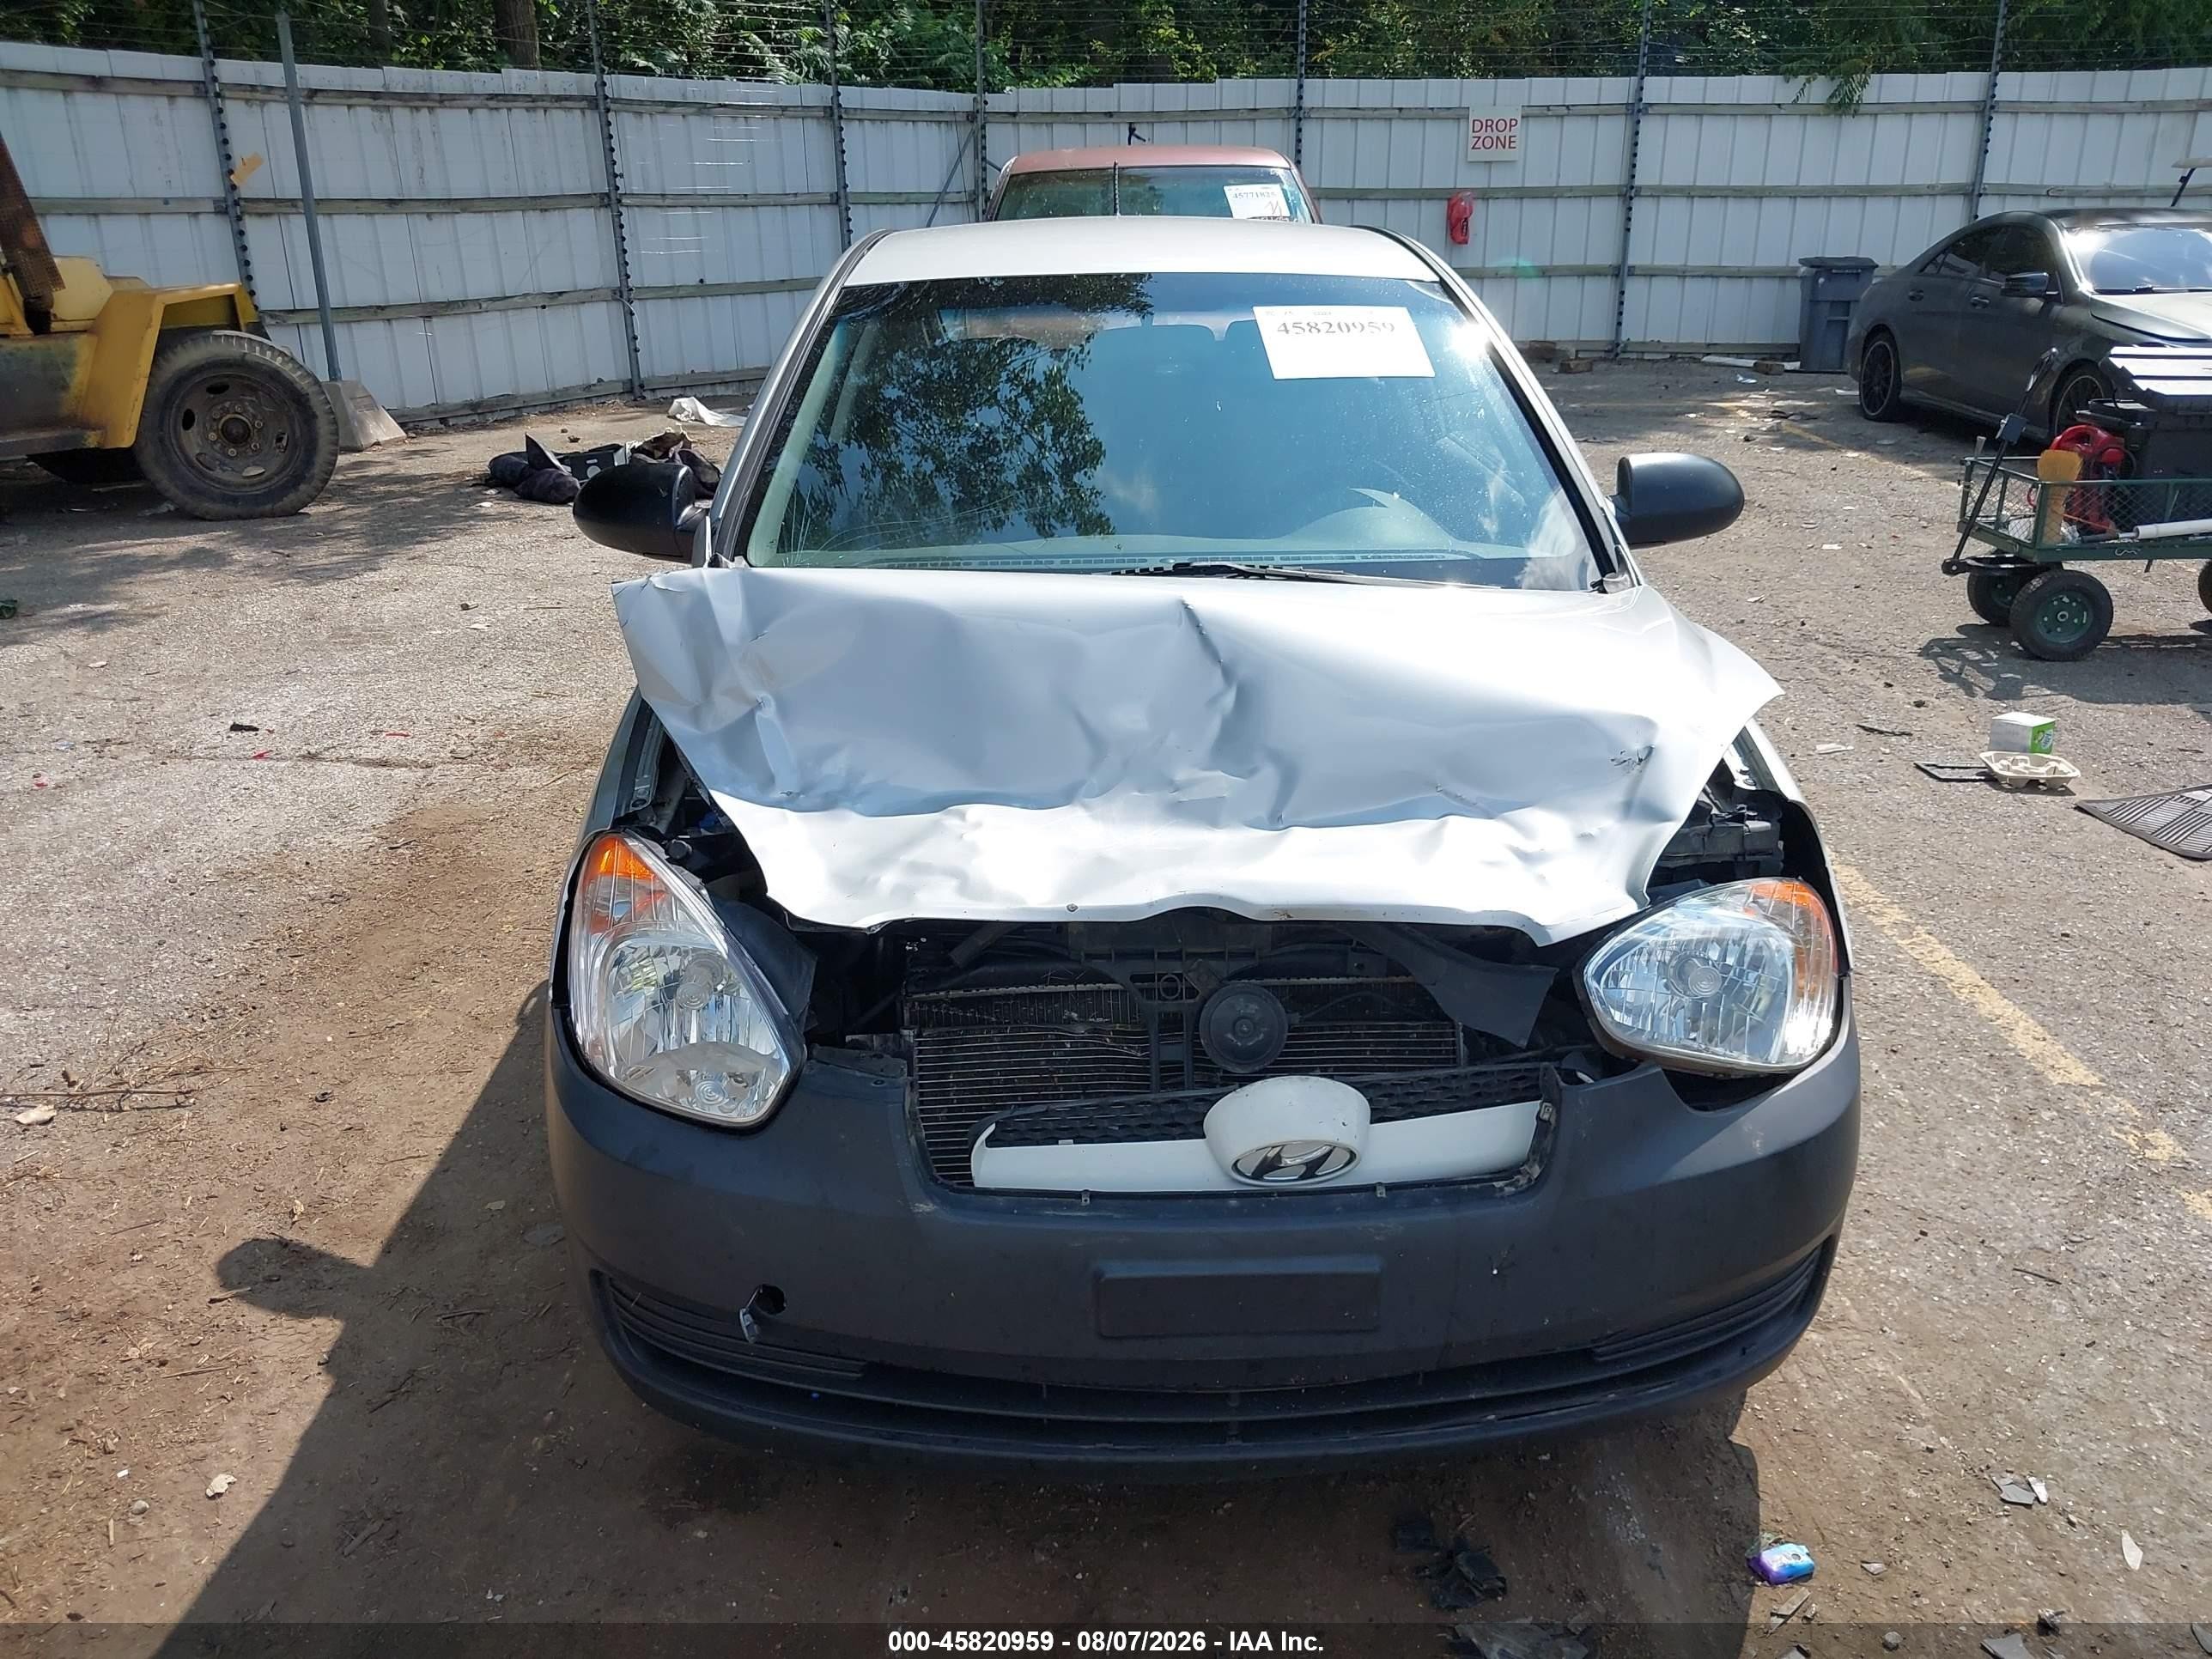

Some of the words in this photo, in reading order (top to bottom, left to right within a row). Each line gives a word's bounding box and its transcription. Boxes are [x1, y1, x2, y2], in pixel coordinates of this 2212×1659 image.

[1472, 118, 1518, 133] DROP
[1471, 135, 1517, 150] ZONE
[1277, 321, 1395, 334] 45820959
